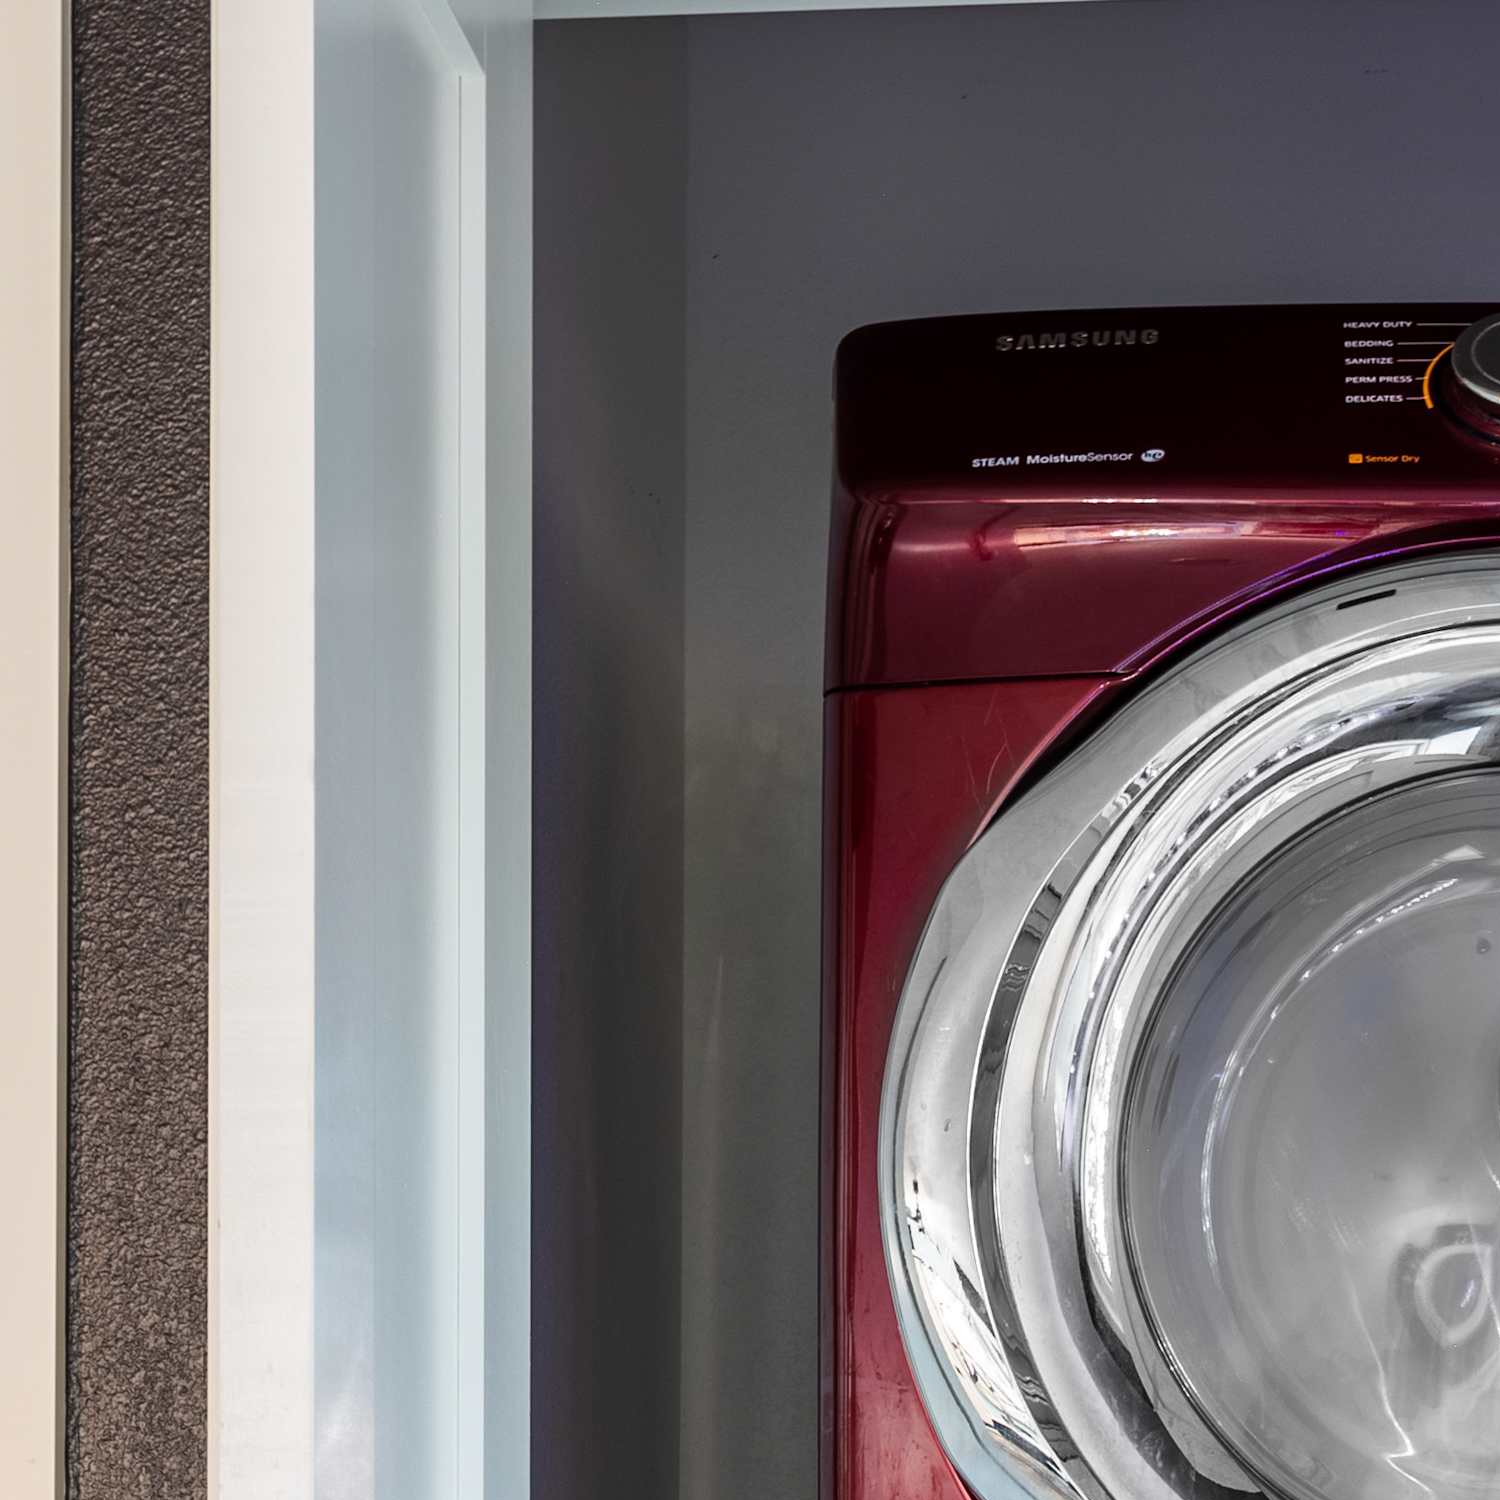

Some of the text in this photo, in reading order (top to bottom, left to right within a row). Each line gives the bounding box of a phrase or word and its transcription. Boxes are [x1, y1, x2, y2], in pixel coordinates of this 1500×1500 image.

[1343, 320, 1413, 330] HEAVY DUTY
[994, 328, 1160, 351] SAMSUNG
[1344, 340, 1395, 348] BEDDING
[1344, 357, 1394, 366] SANITIZE
[1345, 375, 1413, 384] PERM PRESS
[1345, 394, 1404, 404] DELICATES
[971, 455, 1020, 468] STEAM
[1026, 451, 1135, 466] MoistureSensor
[1365, 454, 1420, 464] Sensor Dry
